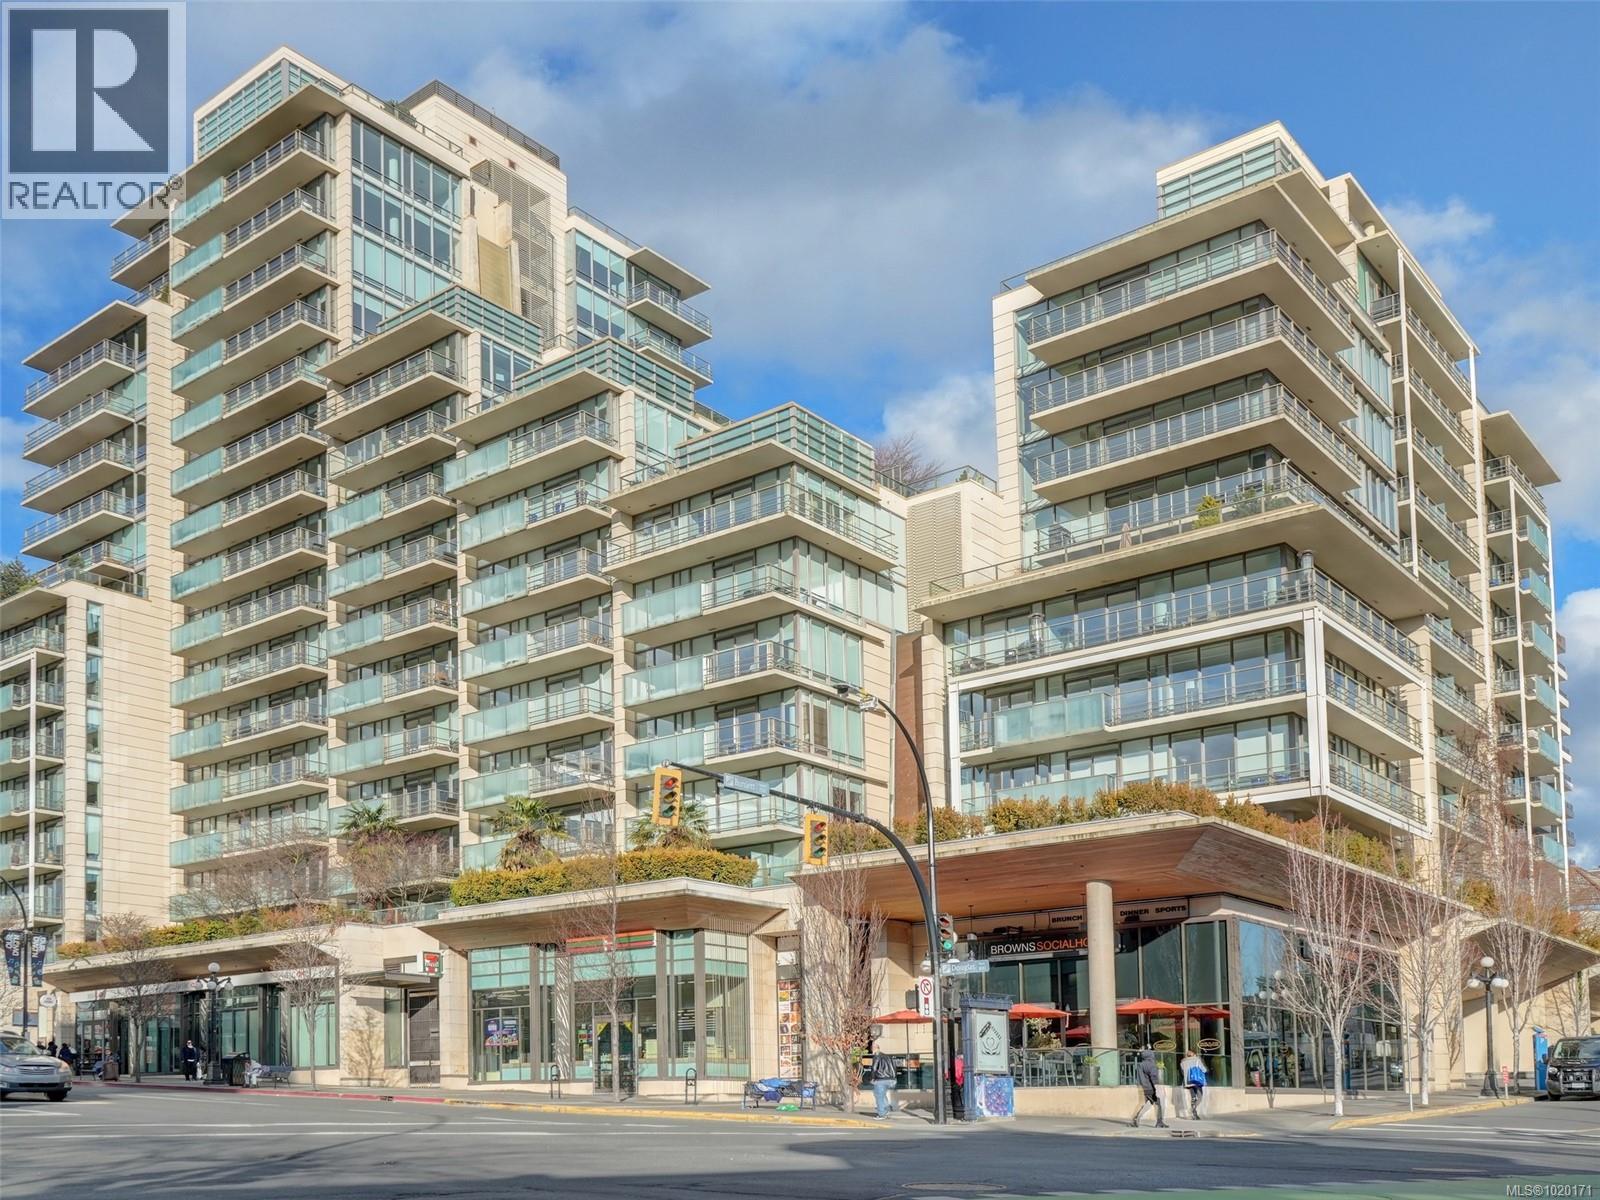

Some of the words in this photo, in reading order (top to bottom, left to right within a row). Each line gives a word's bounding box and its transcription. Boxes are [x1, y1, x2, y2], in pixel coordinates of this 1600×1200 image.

[1120, 908, 1150, 917] DINNER
[1155, 905, 1187, 914] SPORTS
[1051, 915, 1082, 923] BRUNCH
[990, 942, 1036, 955] BROWNS
